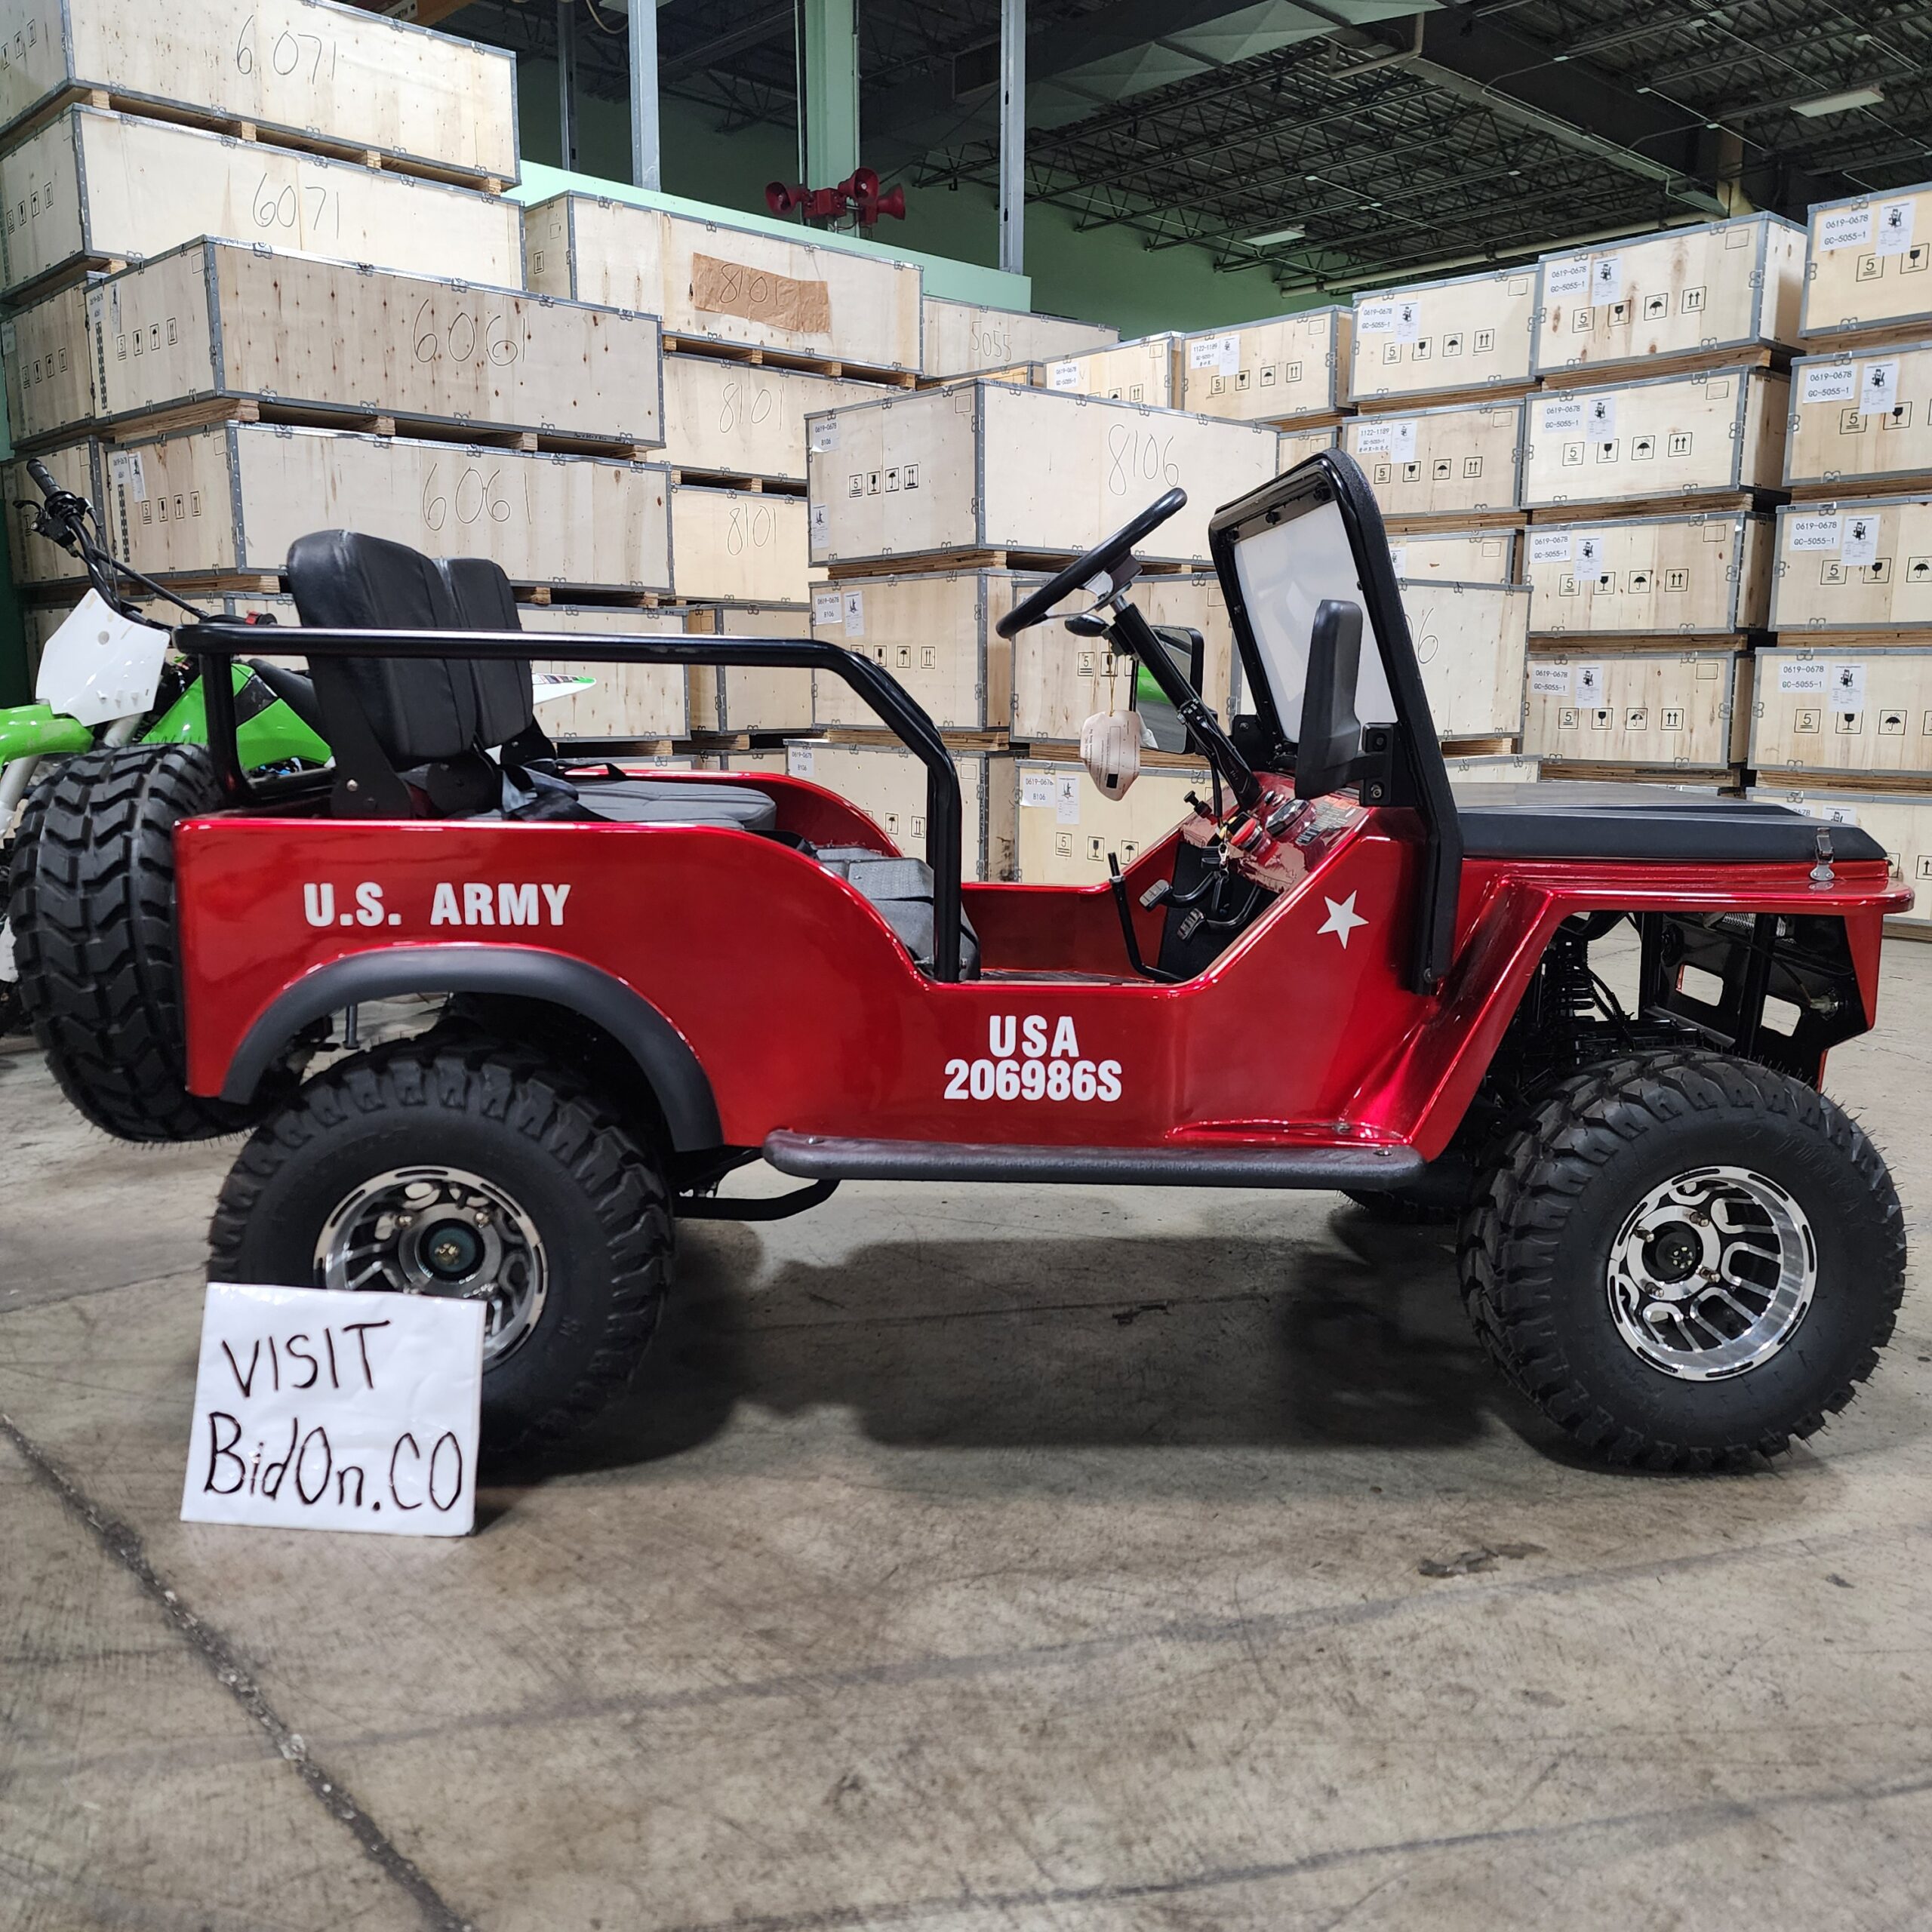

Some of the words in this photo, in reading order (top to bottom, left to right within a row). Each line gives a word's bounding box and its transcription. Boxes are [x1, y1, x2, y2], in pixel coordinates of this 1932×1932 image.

[236, 14, 337, 85] 6071
[253, 172, 340, 239] 6071
[1826, 214, 1869, 229] 0619-0678
[719, 263, 779, 306] 8101
[1551, 266, 1587, 278] 0619-0678
[413, 299, 526, 367] 6061
[971, 321, 1012, 362] 5055
[1807, 386, 1850, 398] GC-5055-1
[1810, 371, 1853, 382] 0619-0678
[720, 383, 783, 434] 8101
[1546, 405, 1581, 415] 0619-0678
[1108, 423, 1179, 496] 8106
[423, 463, 531, 531] 6061
[727, 503, 777, 555] 8101
[1534, 536, 1569, 546] 0619-0678
[1793, 537, 1835, 546] GC-5055-1
[1795, 521, 1838, 531] 0619-0678
[1534, 683, 1566, 692] GC-5055-1
[1535, 669, 1568, 678] 0619-0678
[1783, 665, 1825, 674] 0619-0678
[303, 881, 402, 927] U.S.
[430, 882, 571, 926] ARMY
[989, 1014, 1080, 1058] USA
[943, 1059, 1123, 1102] 206986S
[221, 1320, 391, 1398] VISIT
[204, 1411, 463, 1511] BidOn.CO
